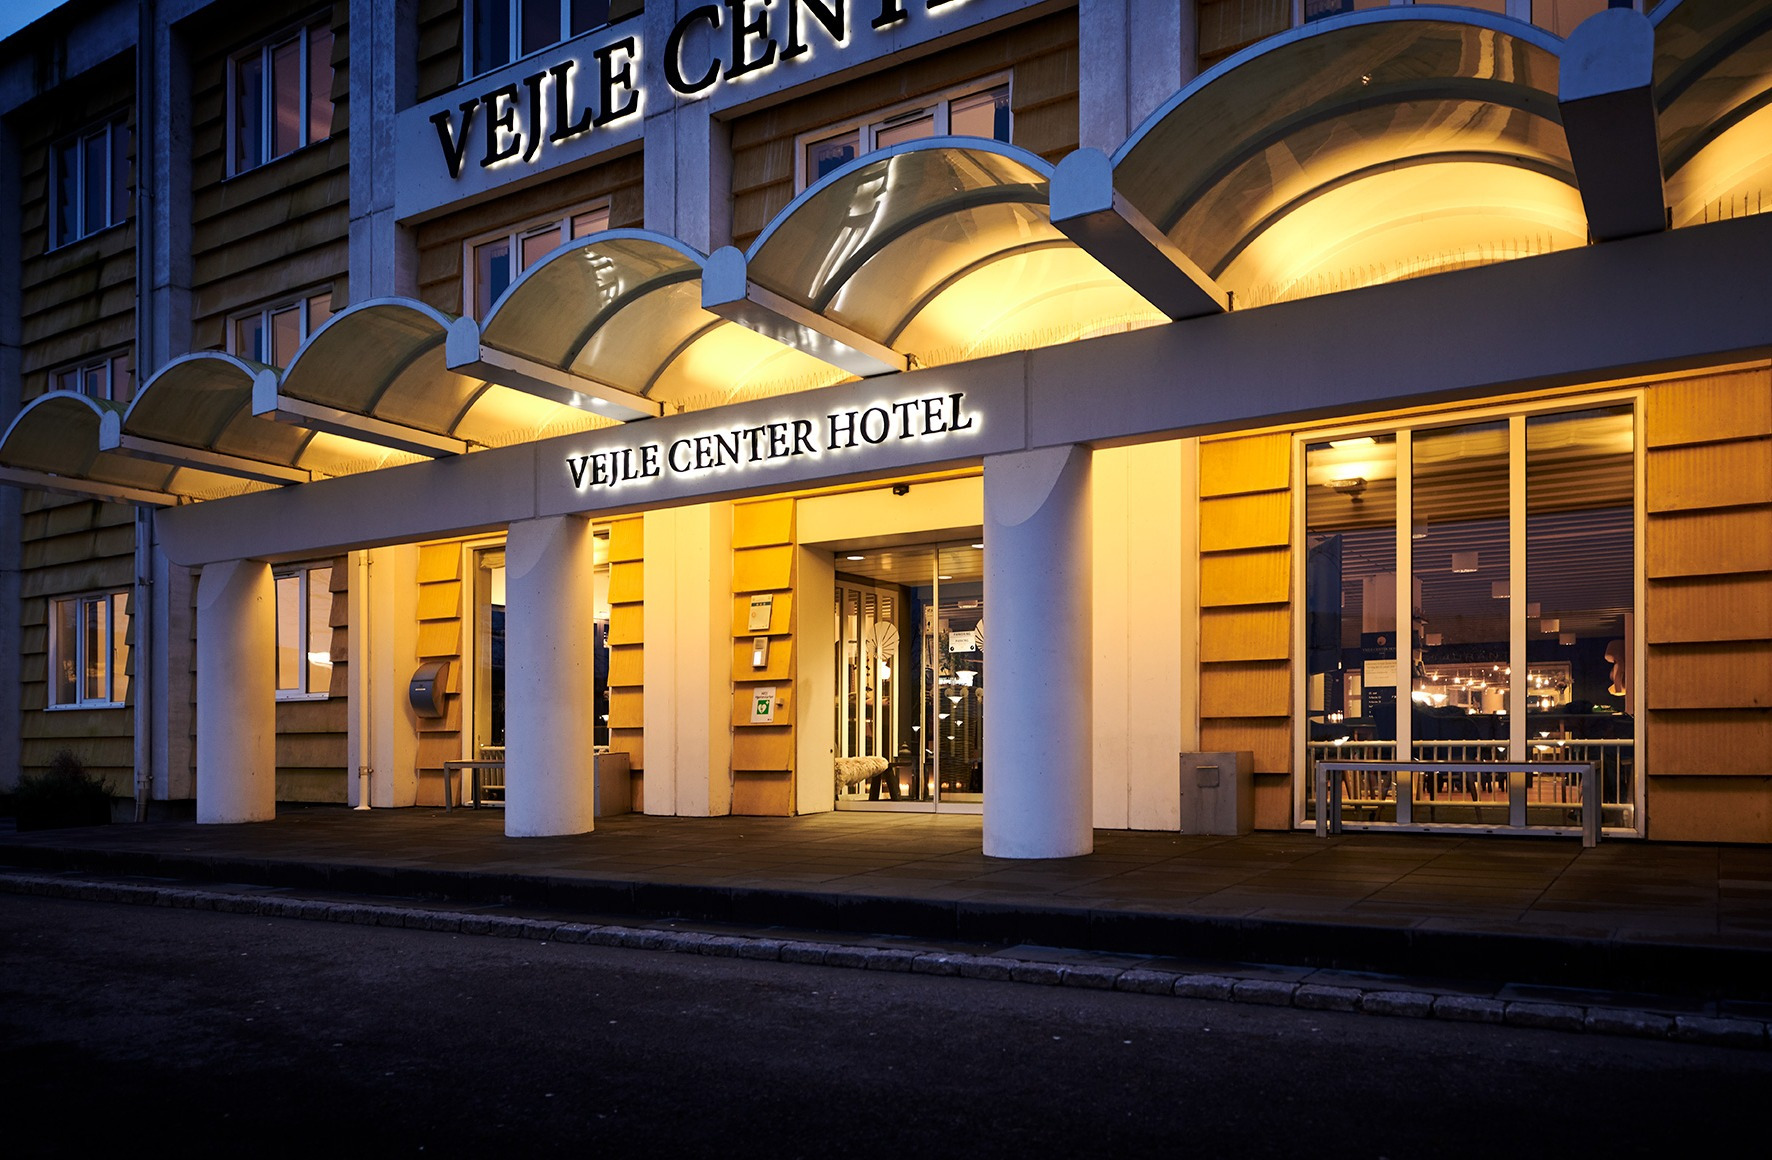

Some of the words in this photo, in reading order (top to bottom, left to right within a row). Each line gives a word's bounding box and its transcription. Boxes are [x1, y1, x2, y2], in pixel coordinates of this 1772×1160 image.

[429, 36, 639, 179] VEJLE
[566, 445, 660, 488] VEJLE
[668, 420, 816, 473] CENTER
[827, 393, 973, 450] HOTEL
